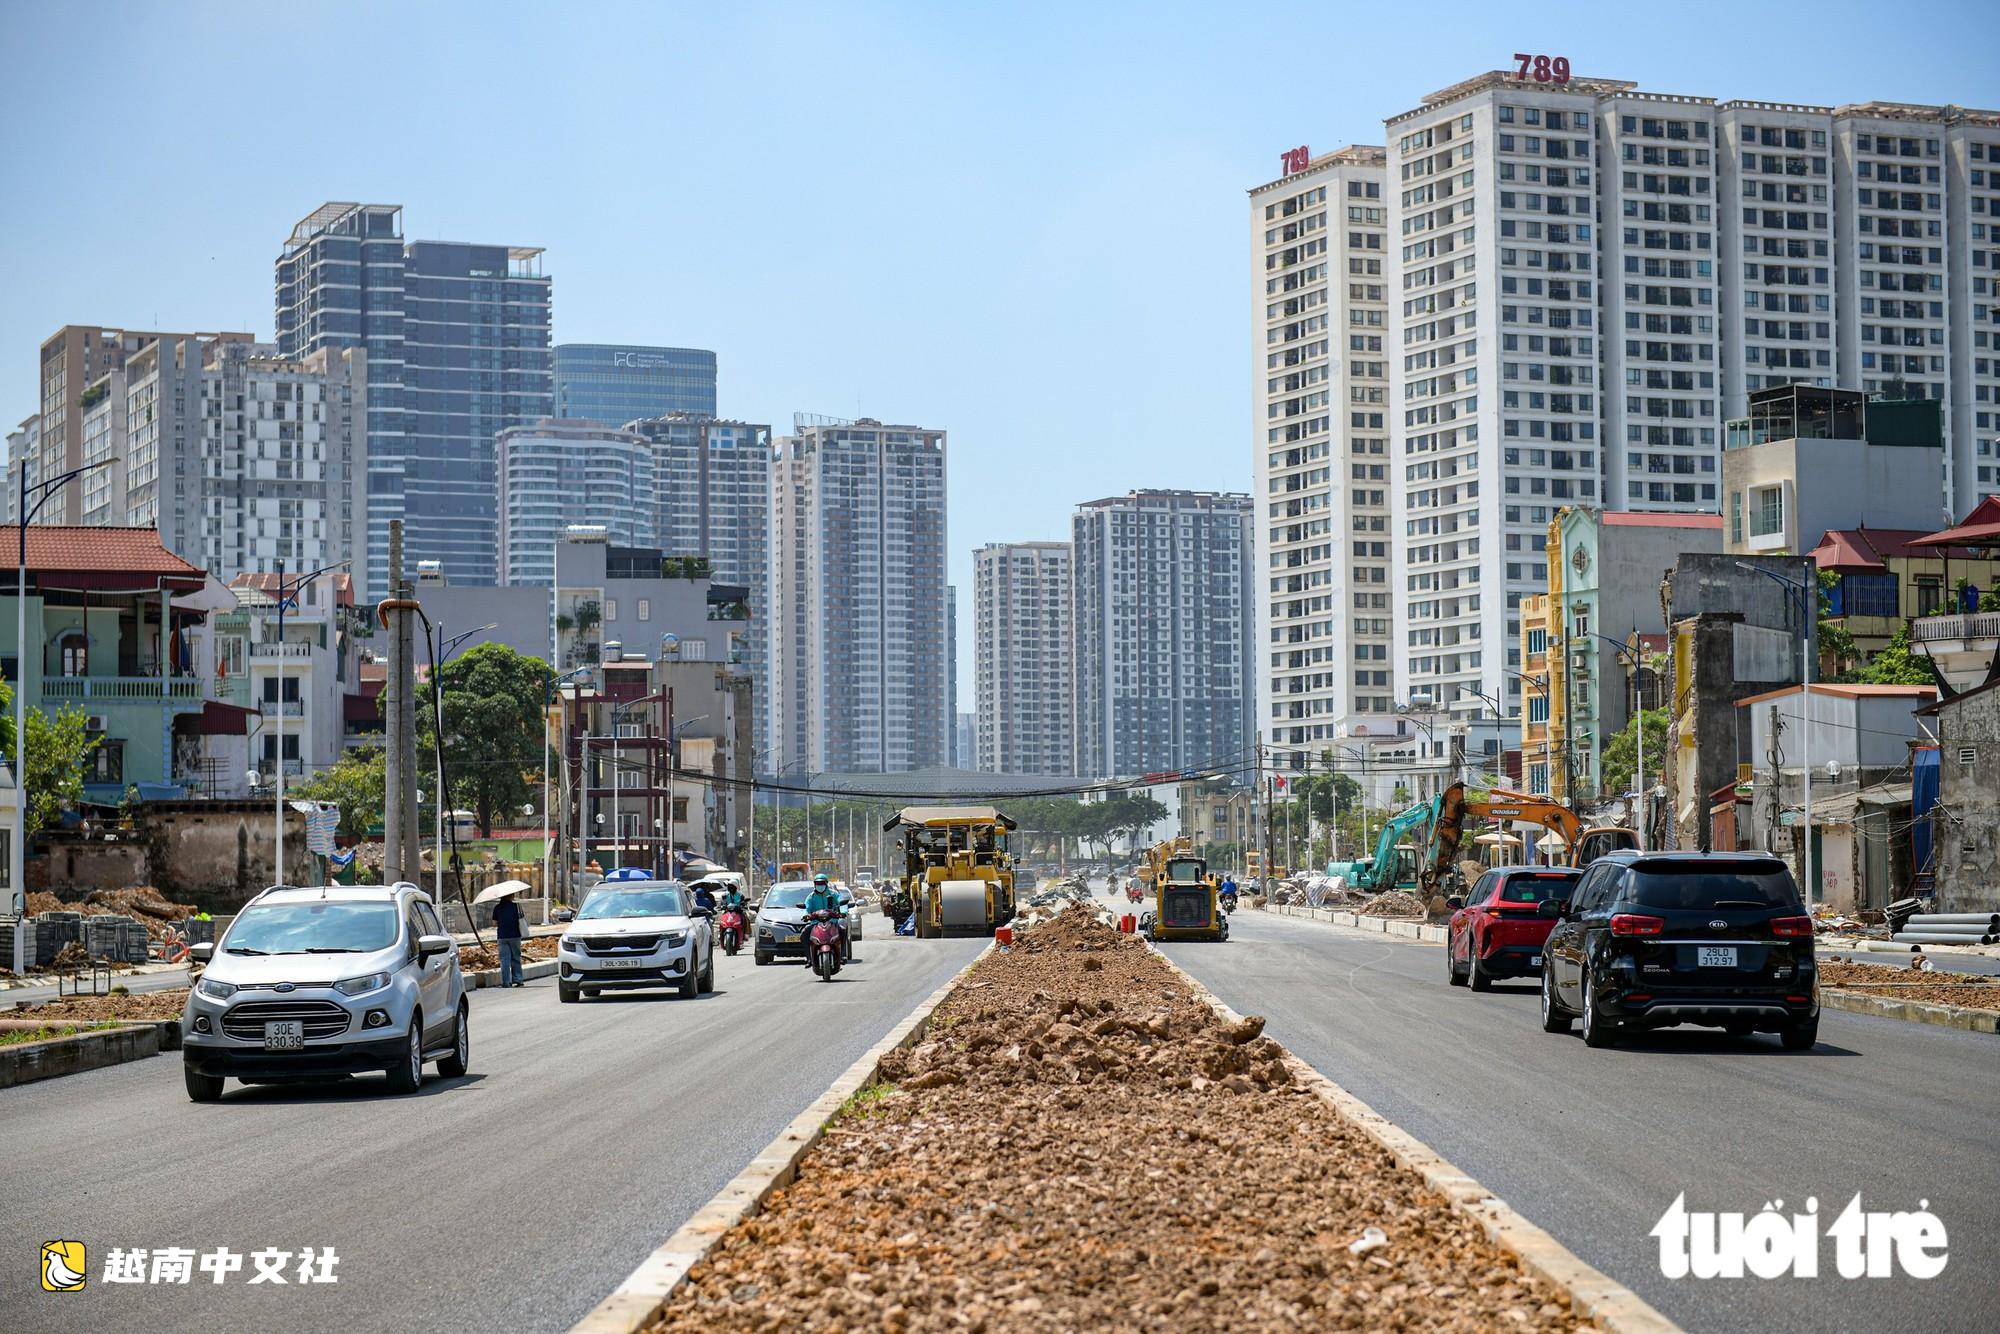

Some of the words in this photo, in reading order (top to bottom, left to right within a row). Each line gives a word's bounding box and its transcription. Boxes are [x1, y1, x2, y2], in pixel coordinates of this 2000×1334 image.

[1514, 54, 1570, 84] 789
[1281, 146, 1309, 177] 789
[1706, 948, 1729, 957] 29LD
[1702, 957, 1733, 966] 312.97
[273, 1023, 294, 1035] 30E
[266, 1036, 302, 1048] 330.39
